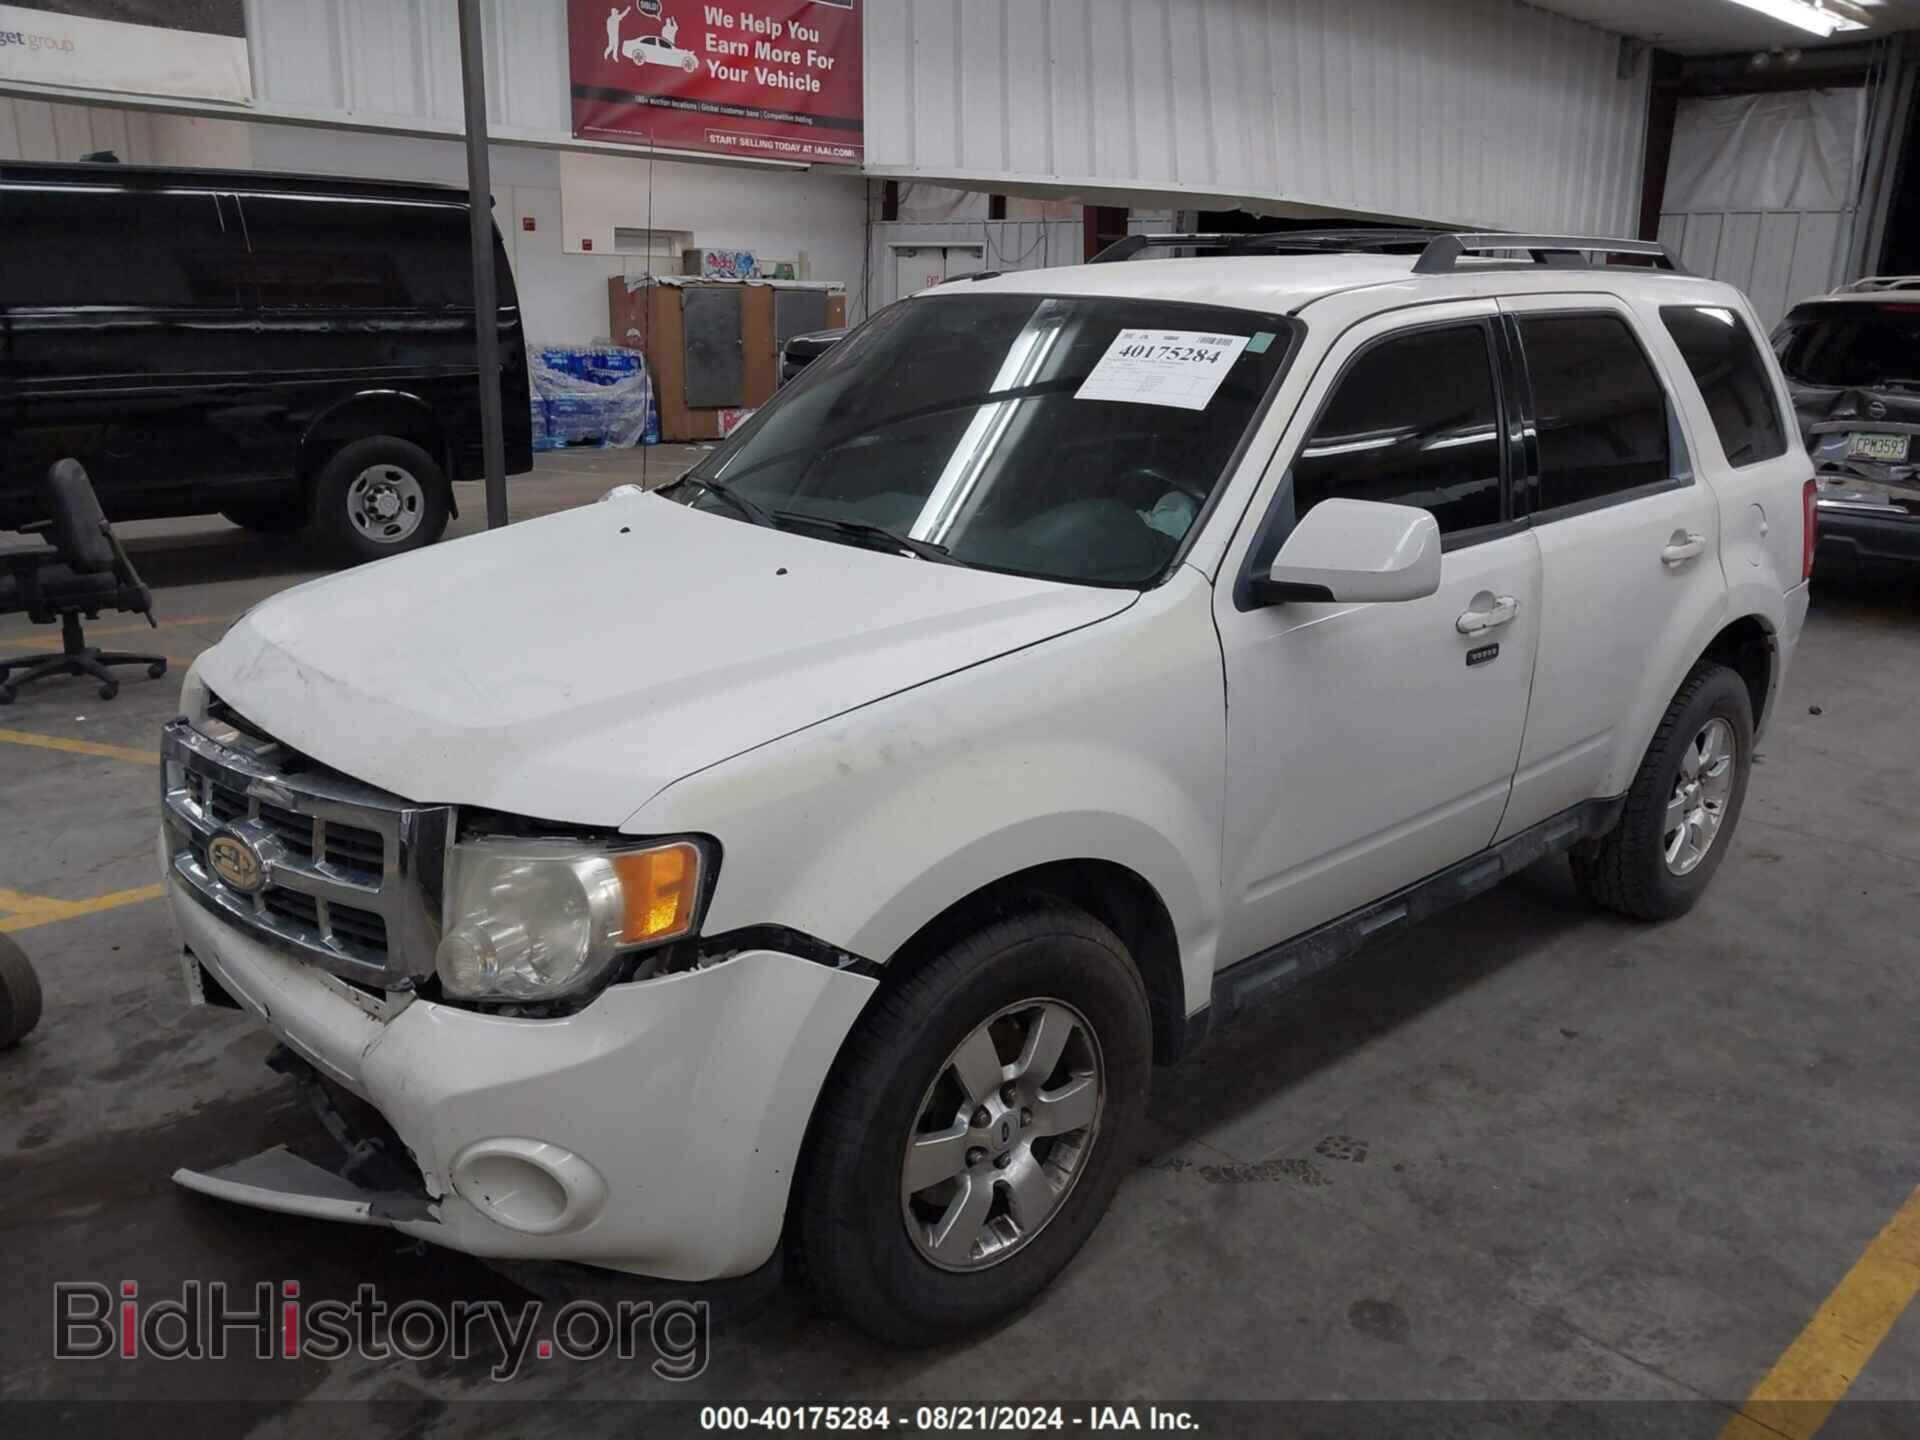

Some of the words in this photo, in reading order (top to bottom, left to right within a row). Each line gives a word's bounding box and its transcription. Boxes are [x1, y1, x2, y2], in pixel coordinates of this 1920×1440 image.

[704, 5, 734, 29] We
[740, 12, 782, 40] Help
[788, 20, 820, 43] You
[704, 32, 749, 57] Earn
[754, 40, 801, 65] More
[806, 50, 835, 70] For
[706, 58, 748, 83] Your
[754, 66, 821, 93] Vehicle
[709, 133, 737, 147] START
[739, 137, 774, 150] SELLING
[774, 141, 801, 153] TODAY
[802, 144, 812, 154] AT
[1118, 344, 1222, 364] 40175284
